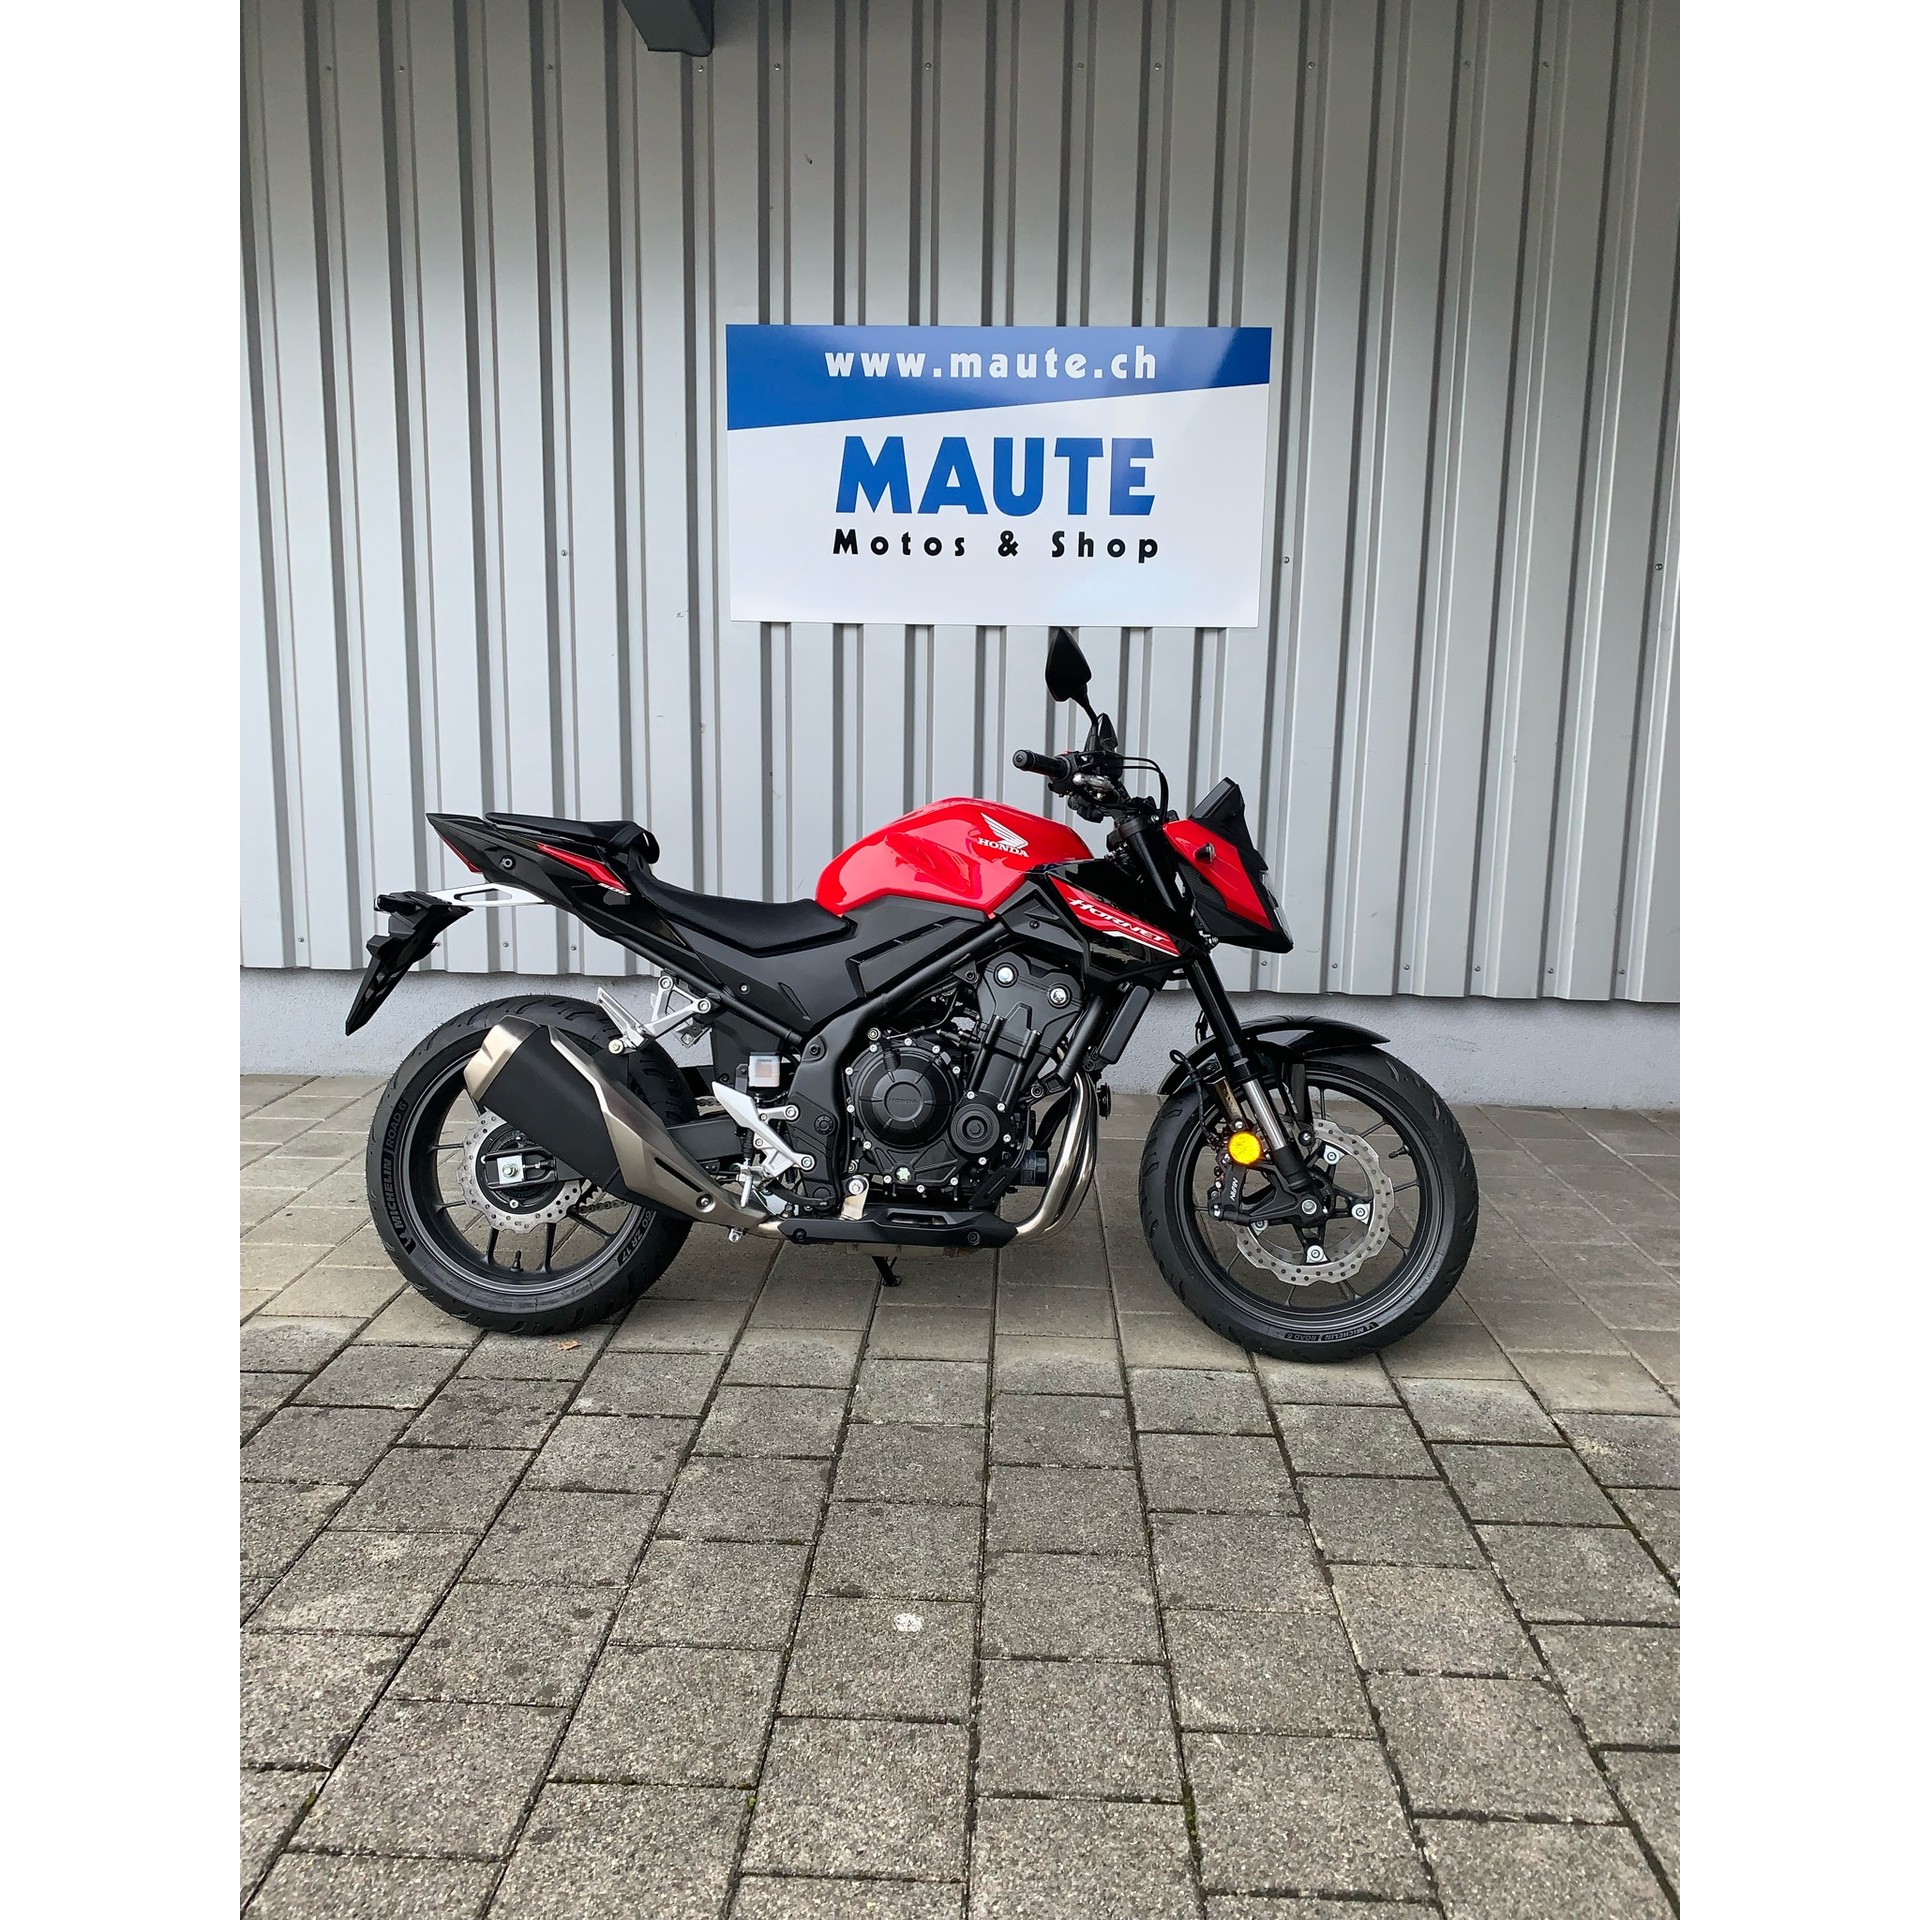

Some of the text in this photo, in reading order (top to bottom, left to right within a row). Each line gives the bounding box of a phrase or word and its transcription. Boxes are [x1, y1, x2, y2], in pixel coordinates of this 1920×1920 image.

[824, 345, 1157, 380] www.maute.ch
[835, 435, 1156, 517] MAUTE
[832, 528, 1159, 564] Motos & Shop
[977, 837, 1030, 858] HONDA
[1066, 897, 1170, 942] HORNET
[385, 1111, 402, 1149] ROAD
[382, 1157, 405, 1230] MICHELIN
[1324, 1326, 1365, 1341] MICHELIN
